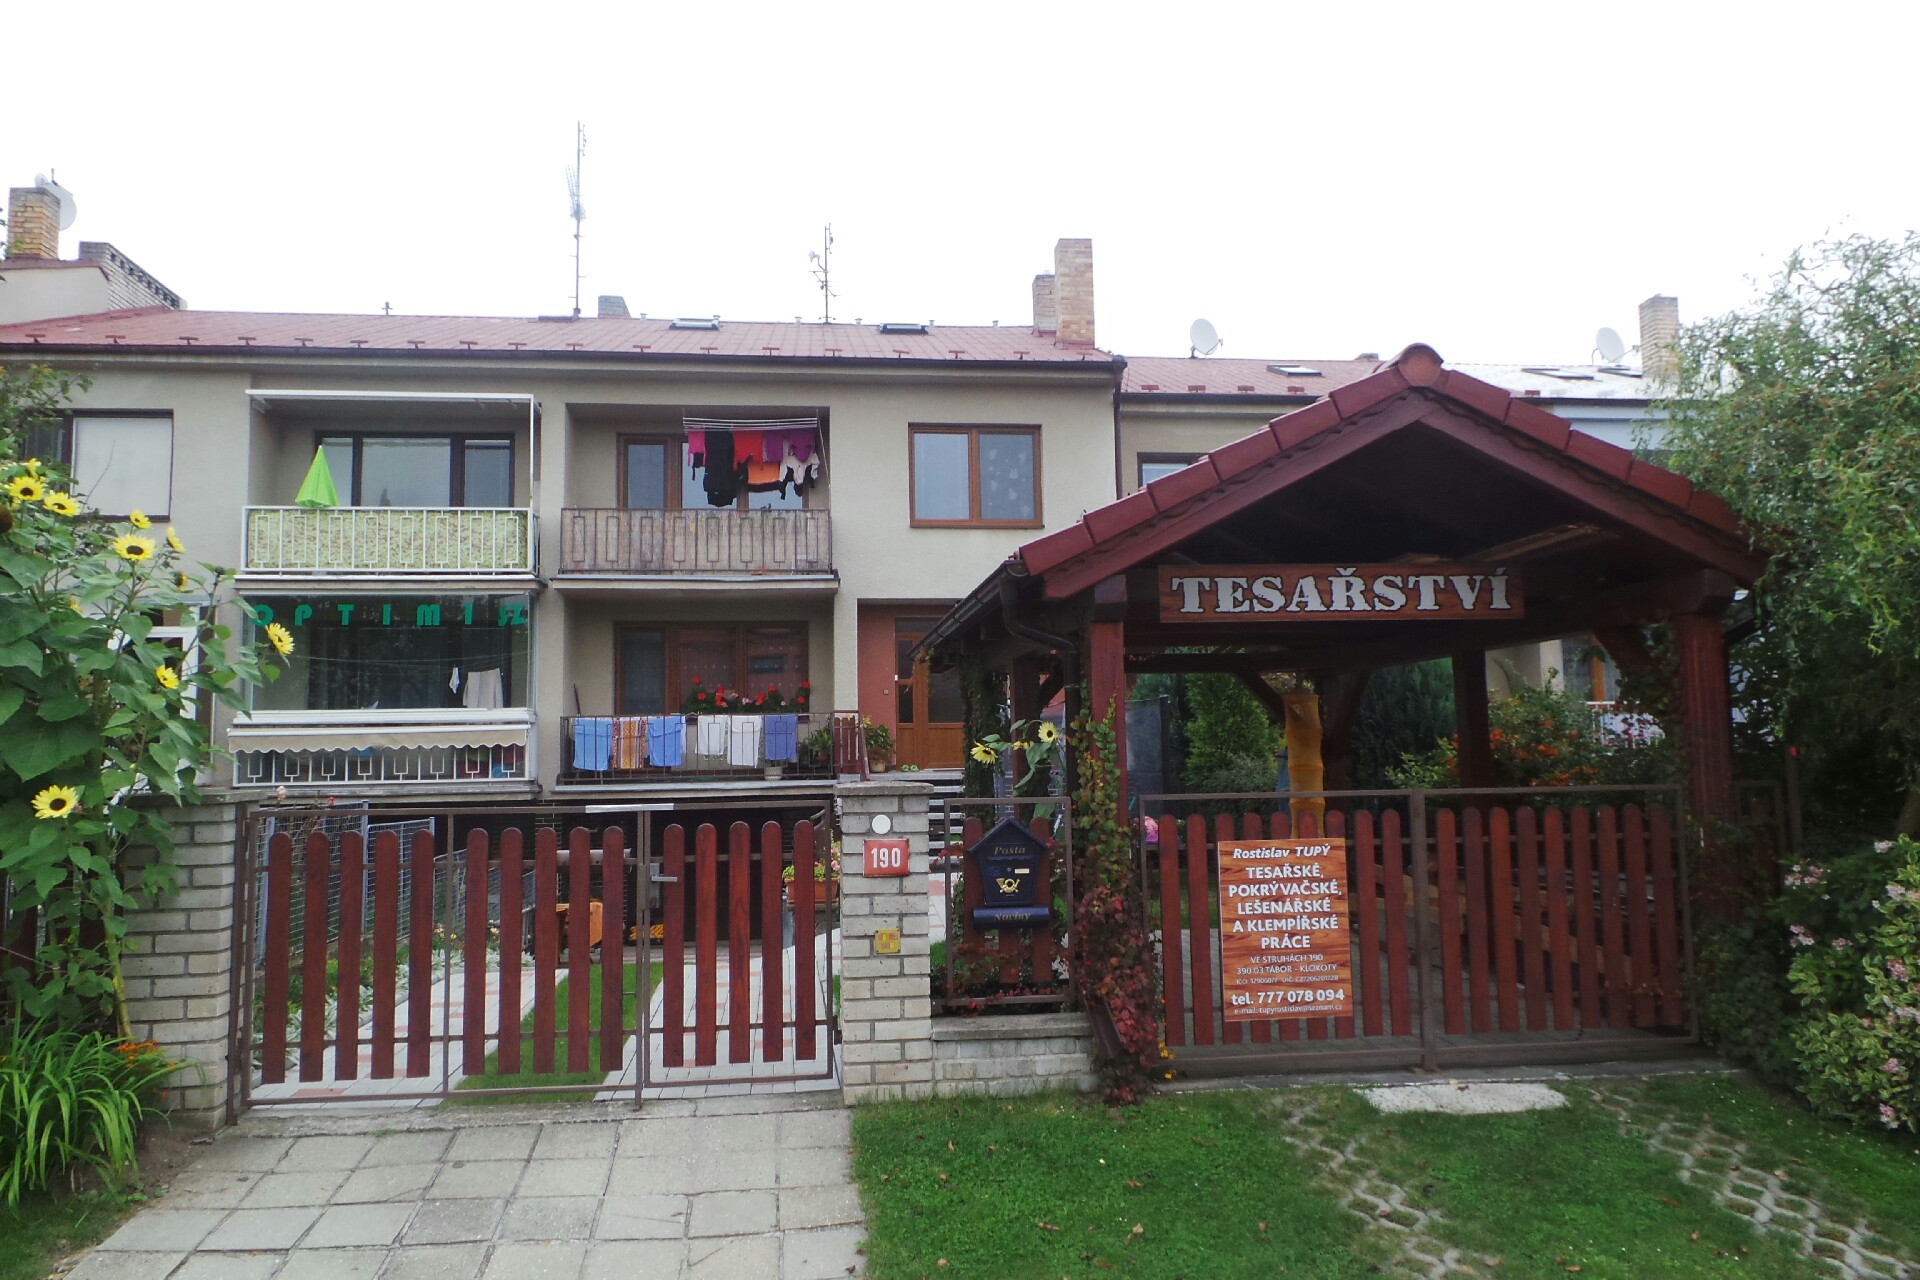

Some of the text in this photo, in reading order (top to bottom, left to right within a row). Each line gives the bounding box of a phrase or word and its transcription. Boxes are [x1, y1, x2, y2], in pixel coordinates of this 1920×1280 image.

[1171, 567, 1511, 613] TESAŘSTVÍ
[871, 847, 901, 868] 190
[1233, 843, 1331, 859] Rostislav TUPÝ
[1245, 863, 1324, 879] TESAŘSKÉ,
[1228, 879, 1342, 897] POKRÝVAČSKÉ,
[1237, 897, 1331, 915] LEŠENÁŘSKÉ
[1232, 915, 1339, 932] A KLEMPÍŘSKÉ
[1261, 933, 1311, 949] PRÁCE
[1250, 956, 1260, 964] VE
[1263, 953, 1307, 963] STRUHÁCH
[1236, 967, 1252, 975] 390
[1265, 964, 1293, 973] TÁBOR
[1300, 964, 1337, 972] KLOKOTY
[1231, 988, 1345, 1005] tel. 777 078 094
